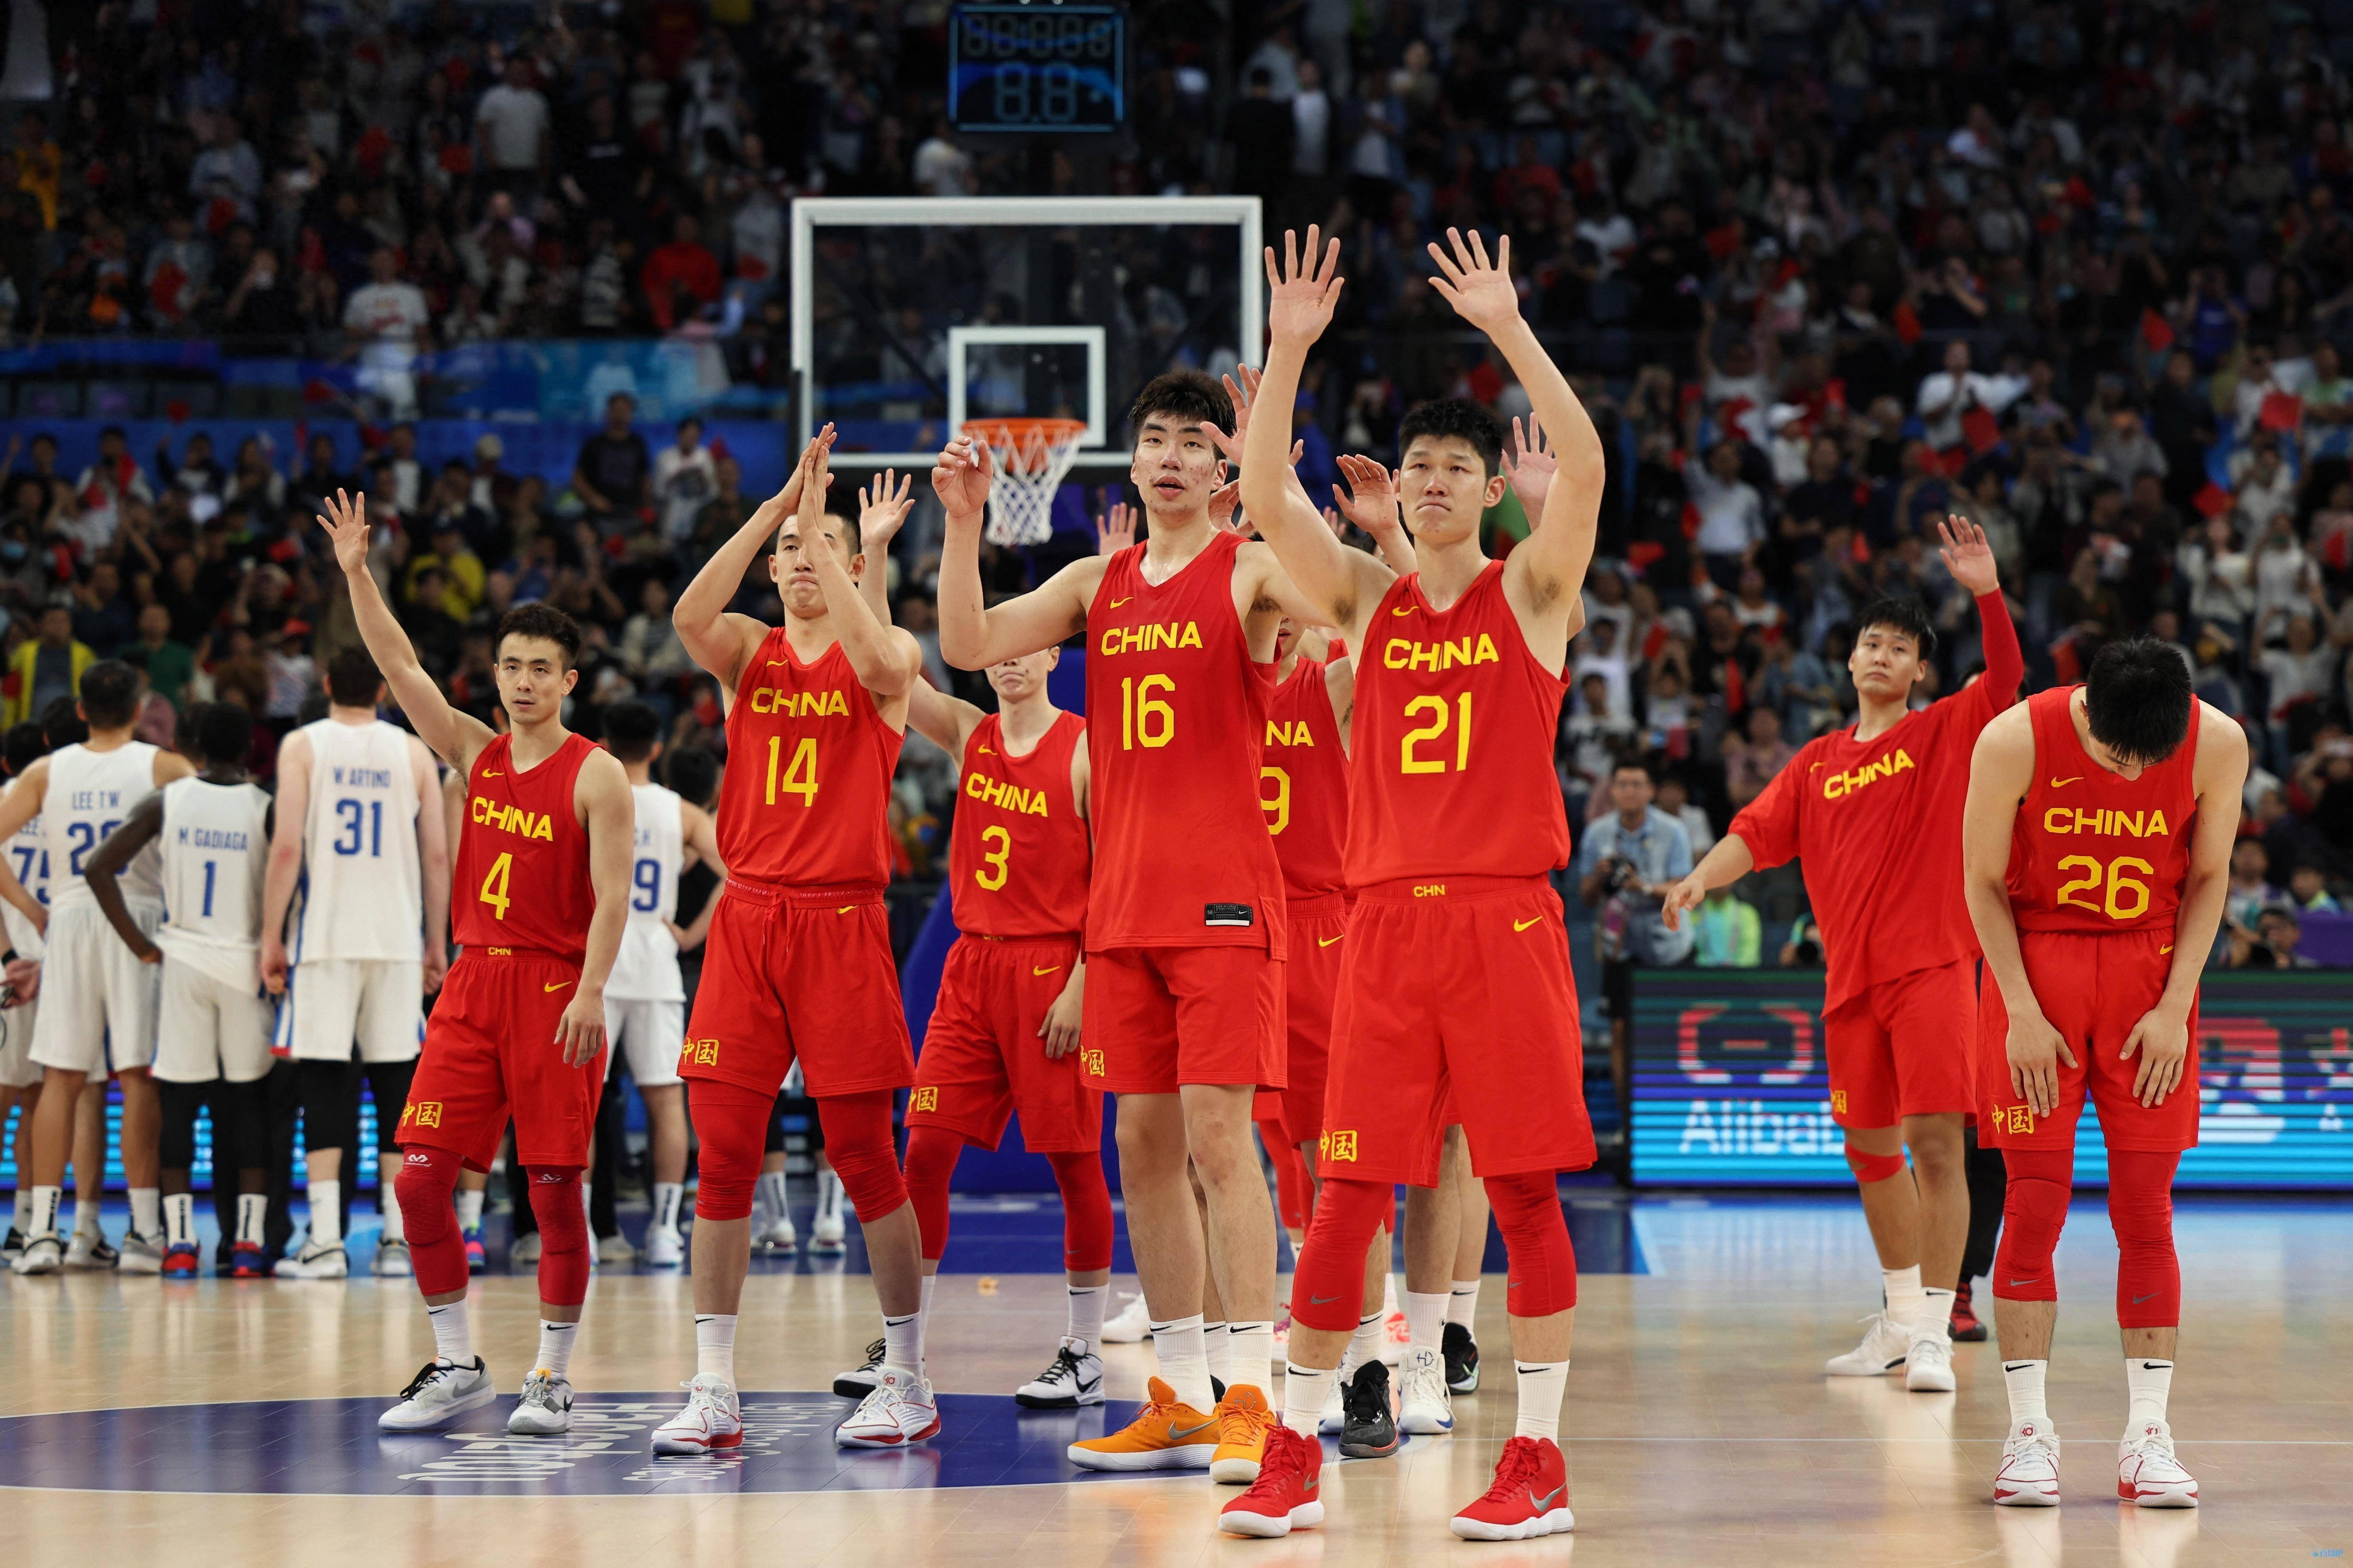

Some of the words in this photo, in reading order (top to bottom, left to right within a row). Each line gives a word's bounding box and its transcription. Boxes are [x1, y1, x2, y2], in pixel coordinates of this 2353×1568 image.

[1101, 621, 1203, 656] CHINA
[1384, 633, 1499, 672] CHINA
[751, 687, 849, 717] CHINA
[1121, 674, 1175, 750] 16
[1401, 692, 1472, 774] 21
[765, 736, 819, 807] 14
[1824, 749, 1915, 799] CHINA
[72, 791, 92, 809] LEE
[966, 772, 1048, 817] CHINA
[1260, 767, 1290, 835] 9
[195, 828, 248, 850] GADIAGA
[335, 799, 382, 857] 31
[473, 796, 553, 841] CHINA
[2044, 808, 2169, 837] CHINA
[975, 825, 1011, 891] 3
[203, 861, 216, 916] 1
[480, 852, 513, 920] 4
[1414, 884, 1445, 897] CHN
[2057, 855, 2154, 919] 26
[488, 947, 511, 955] CHN
[682, 1037, 719, 1066] 中国
[402, 1101, 443, 1128] 中国
[1679, 1098, 1845, 1155] Alibab
[1991, 1104, 2035, 1134] 中国
[1319, 1129, 1358, 1162] 中国
